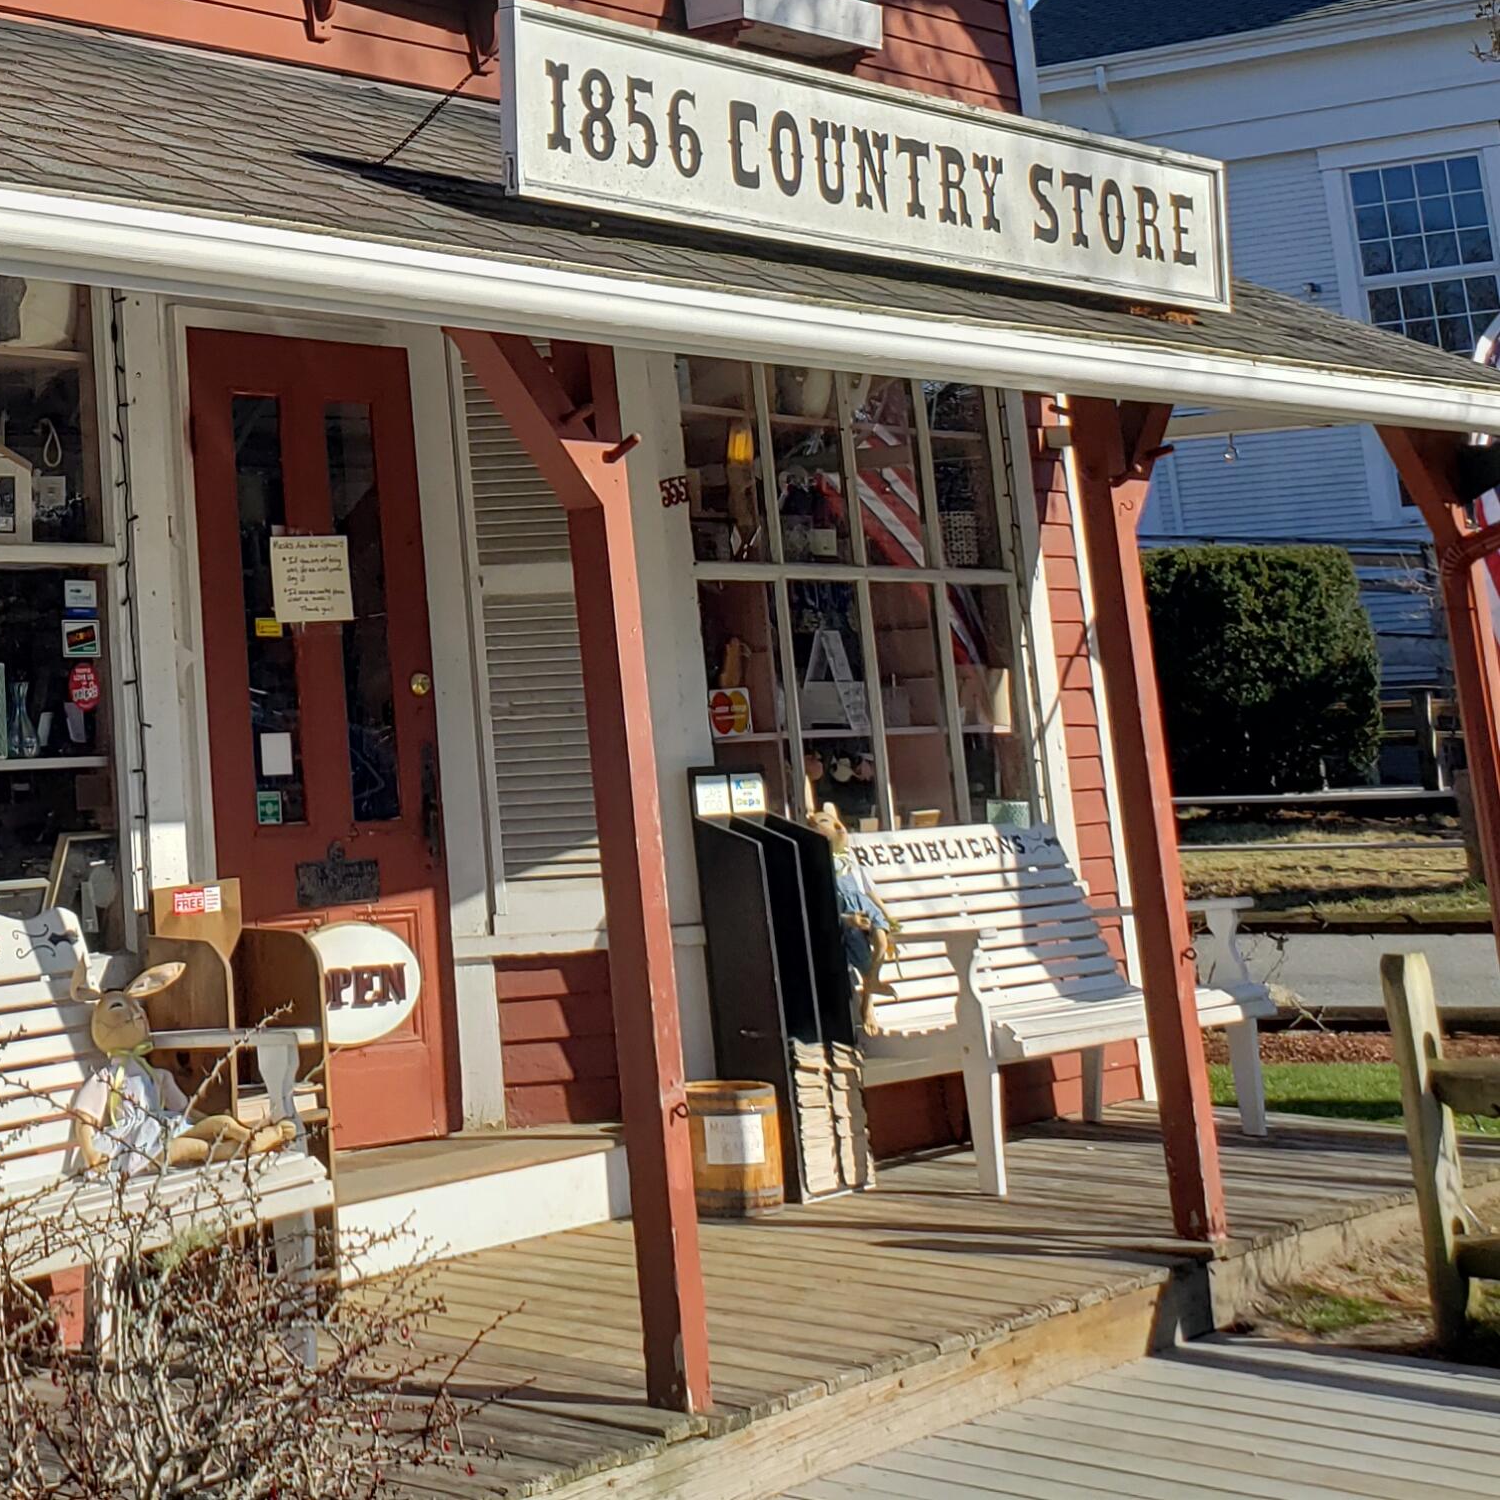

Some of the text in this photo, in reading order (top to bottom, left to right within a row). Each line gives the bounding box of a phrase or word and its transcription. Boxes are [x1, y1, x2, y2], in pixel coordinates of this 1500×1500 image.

[544, 59, 1199, 267] 1856 COUNTRY STORE
[659, 475, 690, 508] 555
[850, 834, 1026, 868] REPUBLICANS
[176, 897, 203, 910] FREE
[324, 962, 407, 1012] PEN
